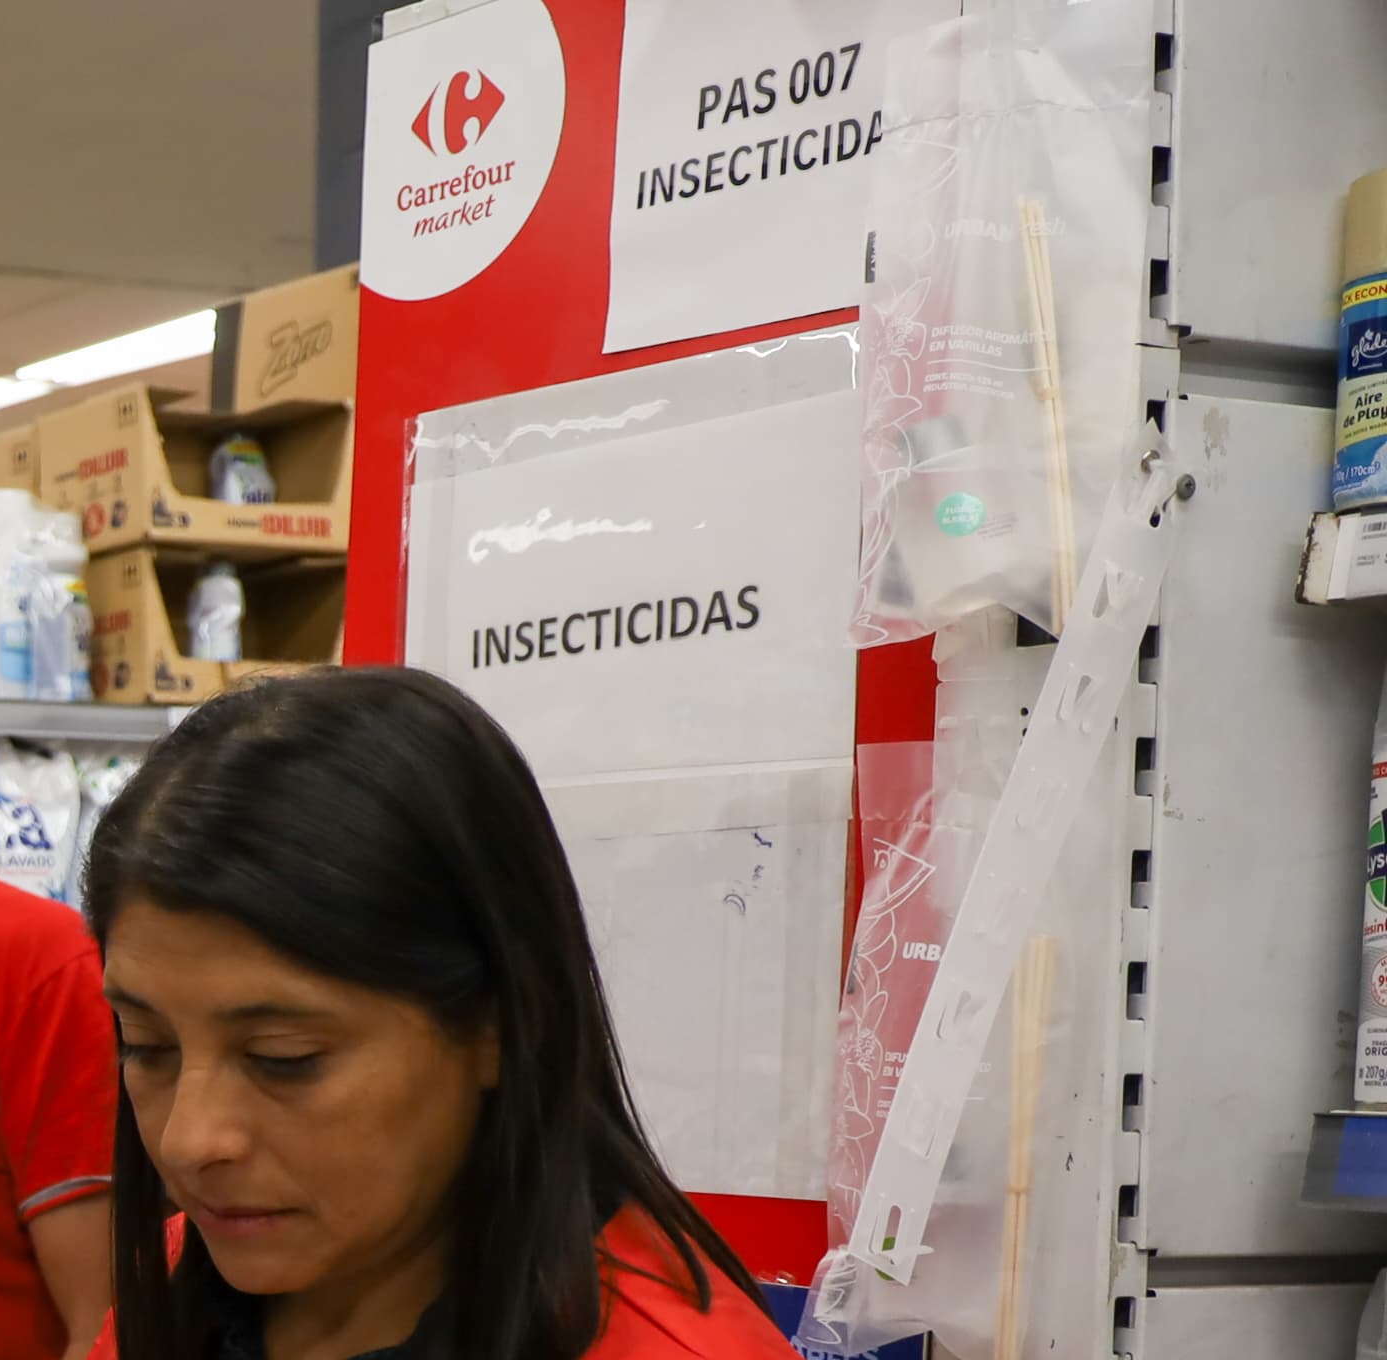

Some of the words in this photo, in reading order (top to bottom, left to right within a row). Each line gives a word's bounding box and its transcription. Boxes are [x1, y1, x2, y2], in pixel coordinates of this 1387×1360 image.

[698, 68, 777, 130] PAS
[789, 42, 863, 104] 007
[397, 159, 515, 212] Carrefour
[414, 194, 495, 238] market
[931, 325, 984, 340] DIFUSOR
[929, 338, 946, 353] EN
[1354, 391, 1383, 411] Aire
[1344, 414, 1357, 430] de
[472, 585, 760, 669] INSECTICIDAS
[902, 942, 942, 962] URB
